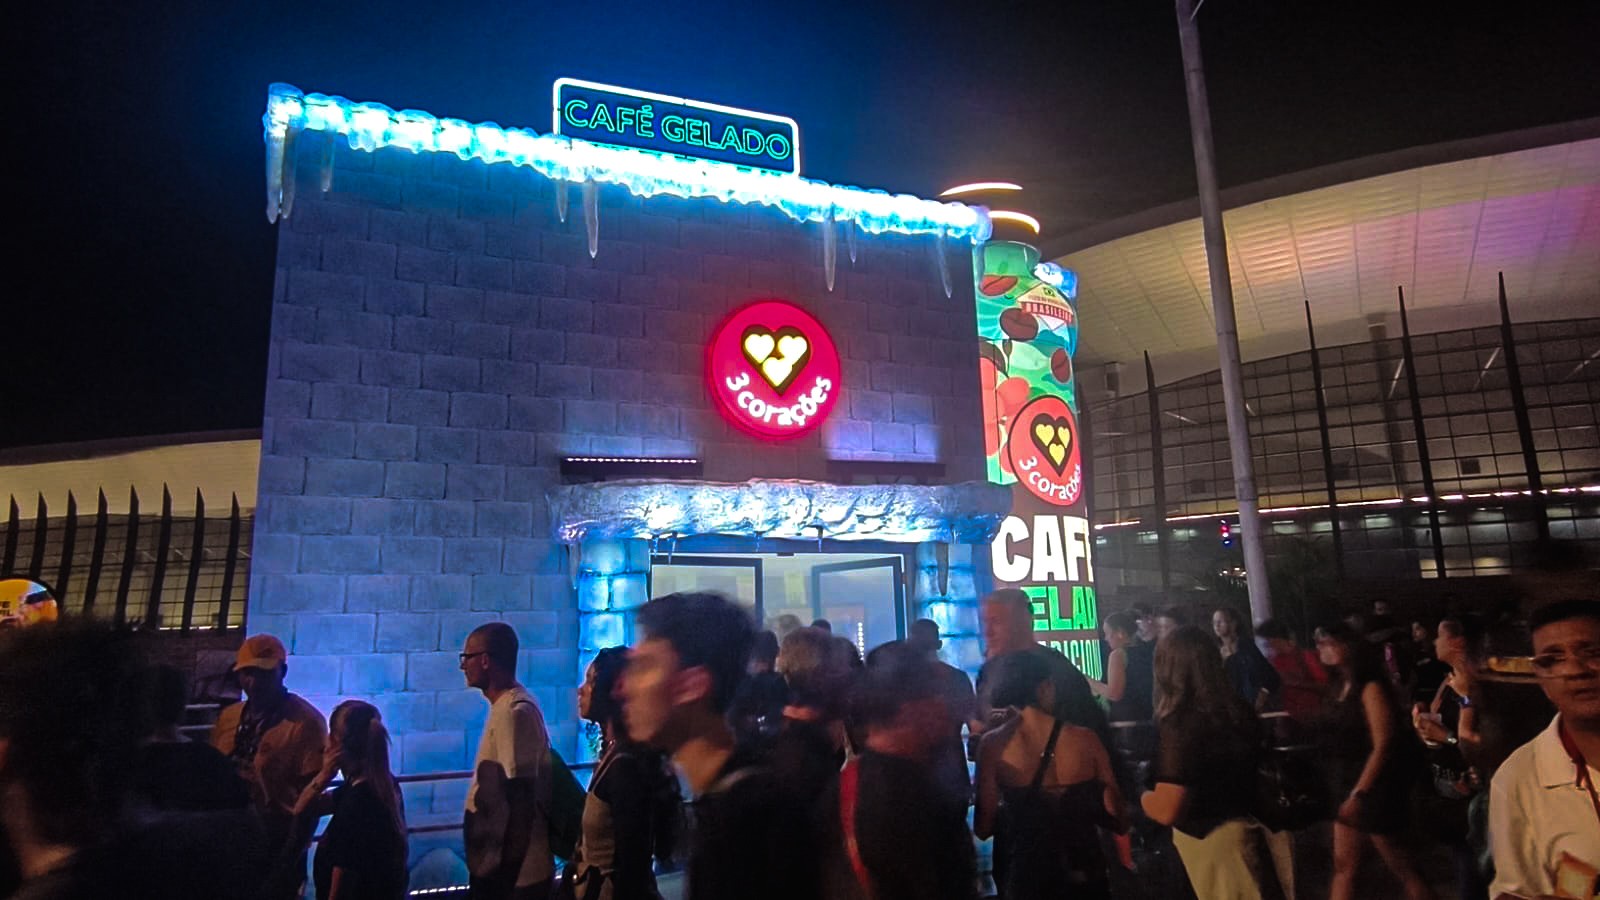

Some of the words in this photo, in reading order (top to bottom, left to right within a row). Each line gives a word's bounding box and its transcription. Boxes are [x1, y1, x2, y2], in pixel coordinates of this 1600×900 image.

[564, 99, 655, 138] CAFÉ
[661, 115, 791, 160] GELADO
[725, 372, 750, 391] 3
[737, 376, 832, 426] corações
[1018, 456, 1038, 470] 3
[991, 506, 1095, 583] CAF
[1019, 586, 1098, 631] ELAD
